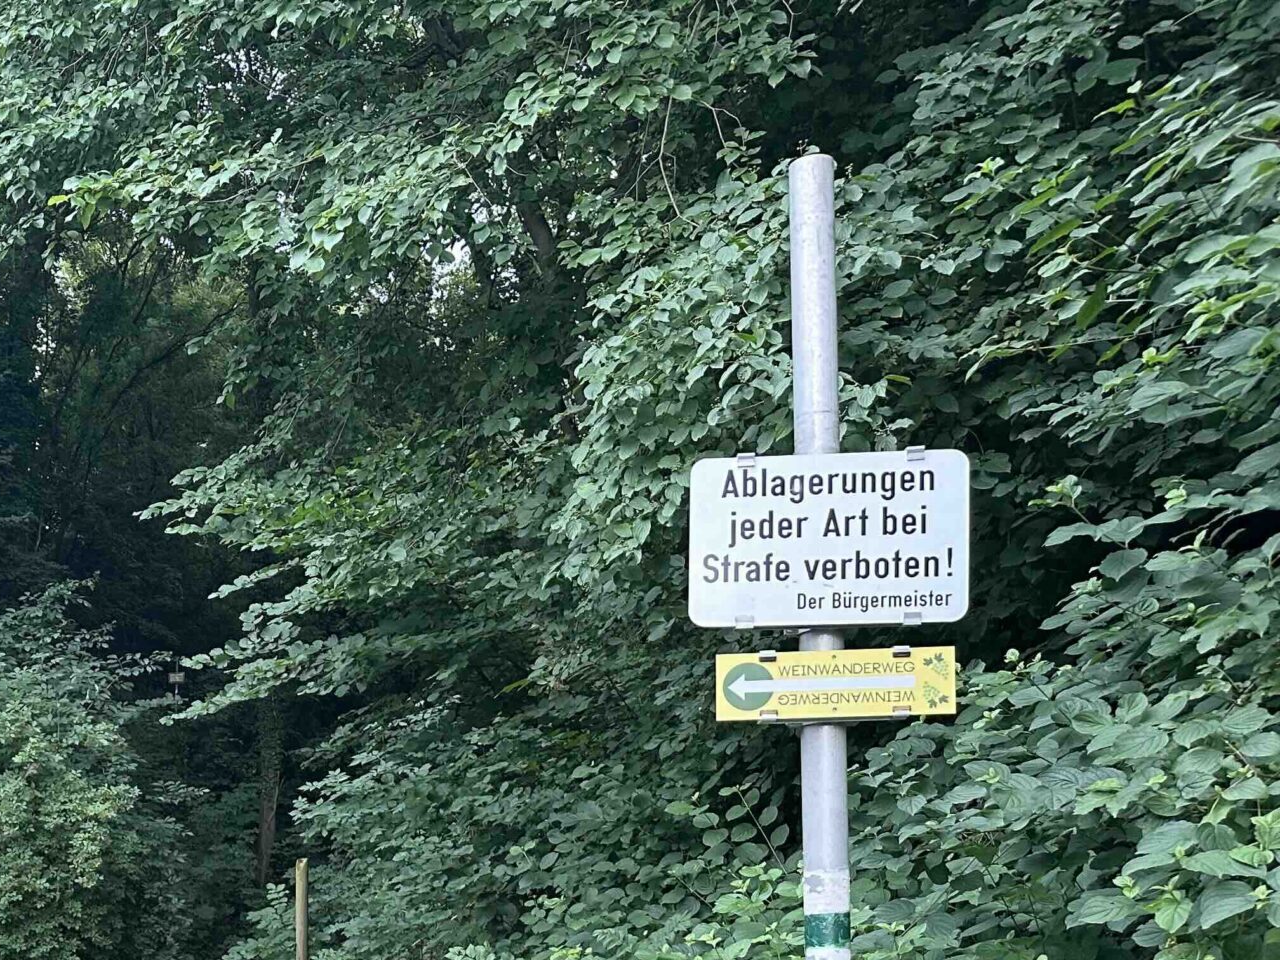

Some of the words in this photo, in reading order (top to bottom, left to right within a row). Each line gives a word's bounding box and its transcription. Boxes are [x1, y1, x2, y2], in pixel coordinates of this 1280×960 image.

[721, 468, 935, 503] Ablagerungen
[728, 510, 808, 548] jeder
[822, 507, 869, 537] Art
[882, 505, 927, 535] bei
[702, 552, 791, 583] Strafe
[804, 547, 953, 580] verboten!
[797, 592, 825, 610] Der
[832, 590, 952, 613] Bürgermeister
[778, 661, 915, 677] WEINWANDERWEG
[778, 690, 915, 706] WEINWANDERWEG
